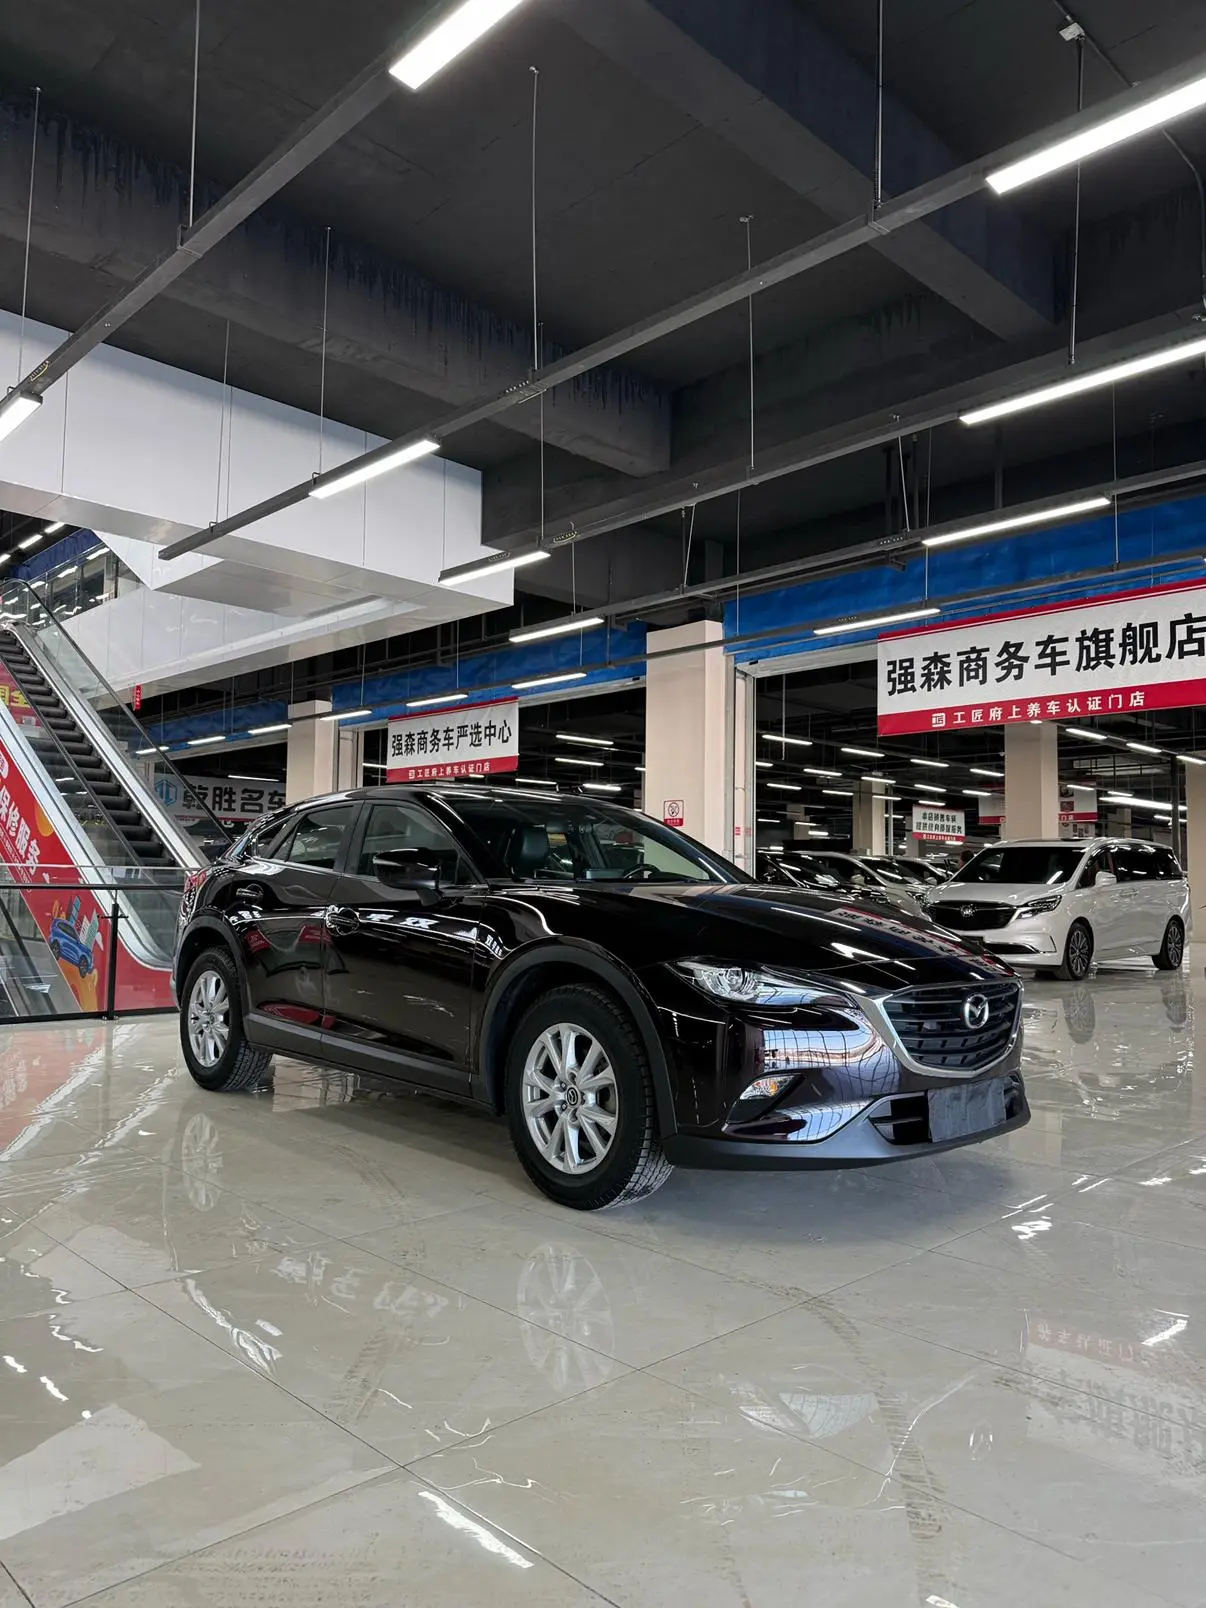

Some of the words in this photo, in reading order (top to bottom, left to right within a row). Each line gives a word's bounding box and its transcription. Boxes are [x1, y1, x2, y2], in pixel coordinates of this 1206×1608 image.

[887, 612, 1206, 697] 强森商务车旗舰店
[952, 690, 1145, 724] 工匠府上养车认证门店
[391, 719, 512, 757] 强森商务车严选中心
